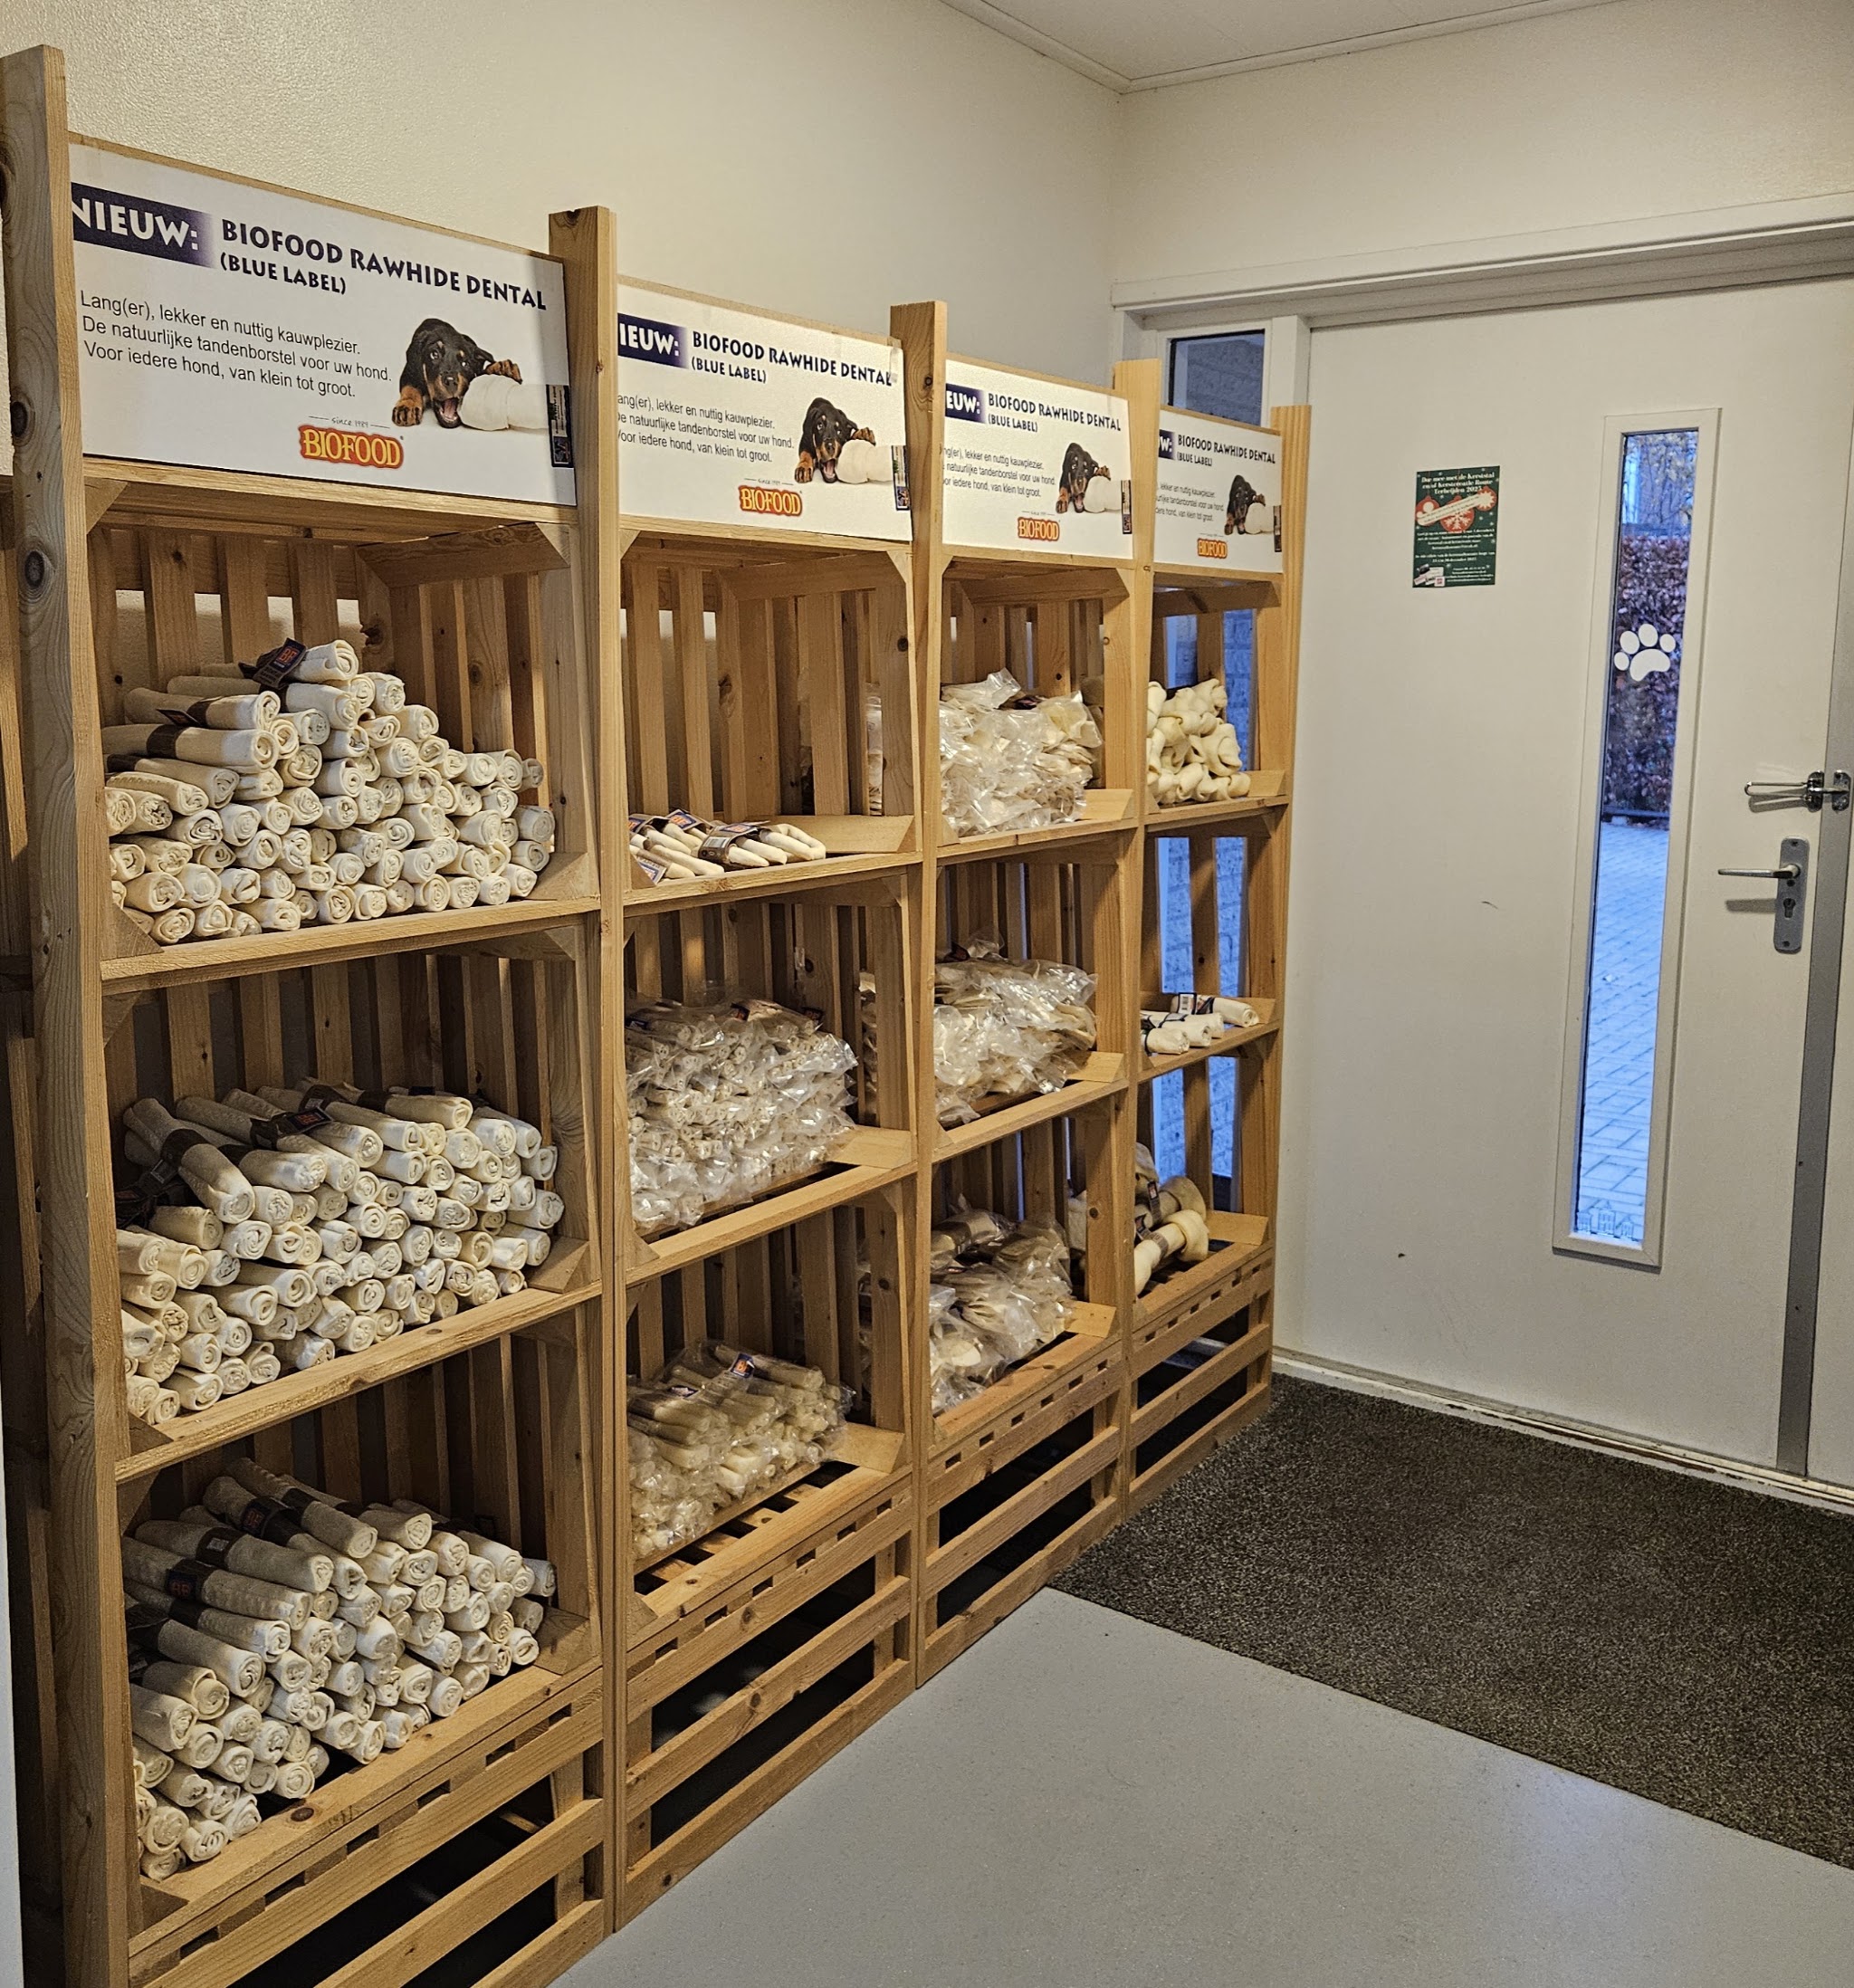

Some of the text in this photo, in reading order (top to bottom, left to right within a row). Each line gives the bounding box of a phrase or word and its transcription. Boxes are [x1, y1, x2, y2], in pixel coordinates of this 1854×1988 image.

[220, 252, 346, 295] (BLUE LABEL)
[222, 218, 547, 311] BIOFOOD RAWHIDE DENTAL
[81, 290, 360, 355] Lang(er), lekker en nuttig kauwplezier.
[82, 315, 392, 381] De natuurlijke tandenborstel voor uw hond.
[693, 330, 892, 387] BIOFOOD RAWHIDE DENTAL
[83, 339, 356, 397] Voor iedere hond, van klein tot groot.
[692, 356, 767, 384] (BLUE LABEL)
[656, 398, 683, 414] lekker
[685, 406, 697, 416] en
[699, 408, 723, 424] nuttig
[724, 410, 775, 429] kauwplezier.
[988, 393, 1121, 431] BIOFOOD RAWHIDE DENTAL
[988, 413, 1038, 433] (BLUE LABEL)
[302, 429, 401, 466] BIOFOOD
[629, 415, 675, 433] natuurlijke
[678, 420, 737, 440] tandenborstel
[738, 432, 757, 444] voor
[758, 435, 770, 445] uw
[772, 435, 795, 449] hond.
[638, 432, 667, 447] iedere
[669, 436, 695, 454] hond,
[697, 443, 712, 454] van
[714, 444, 734, 457] klein
[736, 447, 748, 459] tot
[749, 451, 773, 463] groot.
[1159, 435, 1173, 453] W:
[1178, 434, 1276, 464] BIOFOOD RAWHIDE DENTAL
[741, 488, 801, 514] BIOFOOD
[1018, 519, 1058, 540] BIOFOOD
[1199, 540, 1226, 558] BIOFOOD
